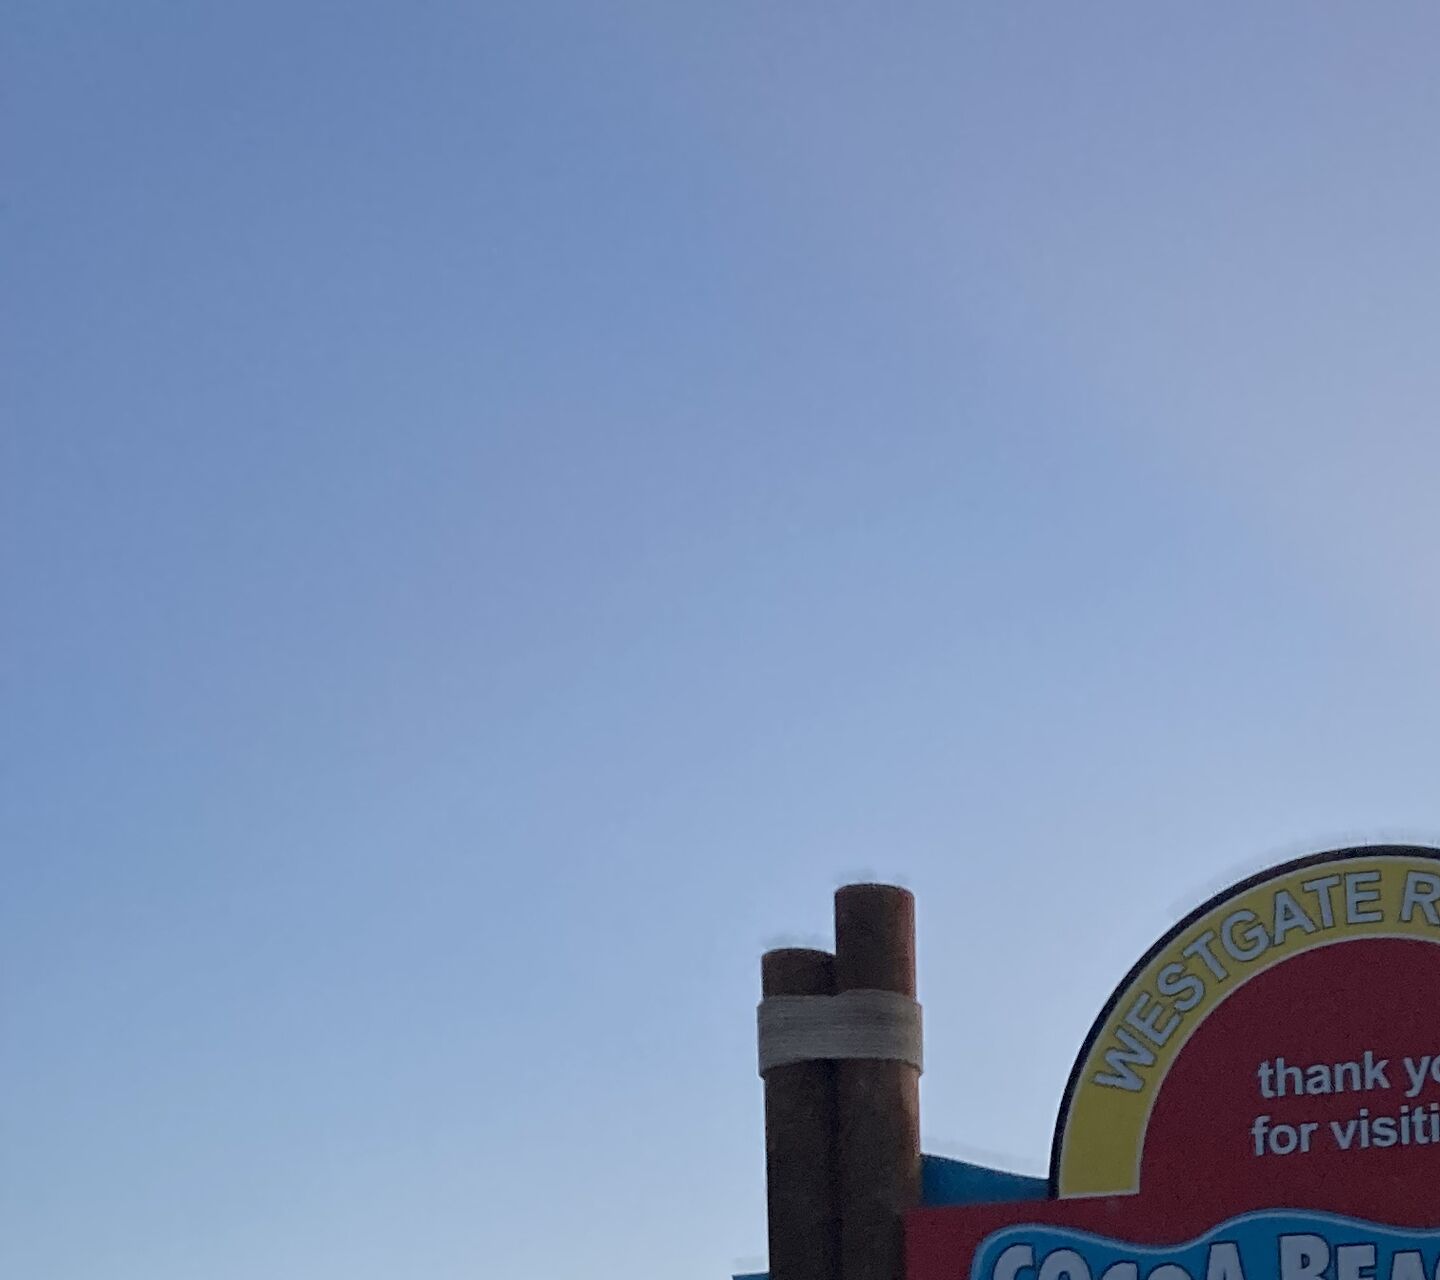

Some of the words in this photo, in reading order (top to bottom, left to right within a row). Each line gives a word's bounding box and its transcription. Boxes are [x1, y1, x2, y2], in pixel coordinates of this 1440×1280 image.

[1093, 869, 1384, 1093] WESTGATE
[1257, 1050, 1391, 1099] thank
[1251, 1113, 1319, 1157] for
